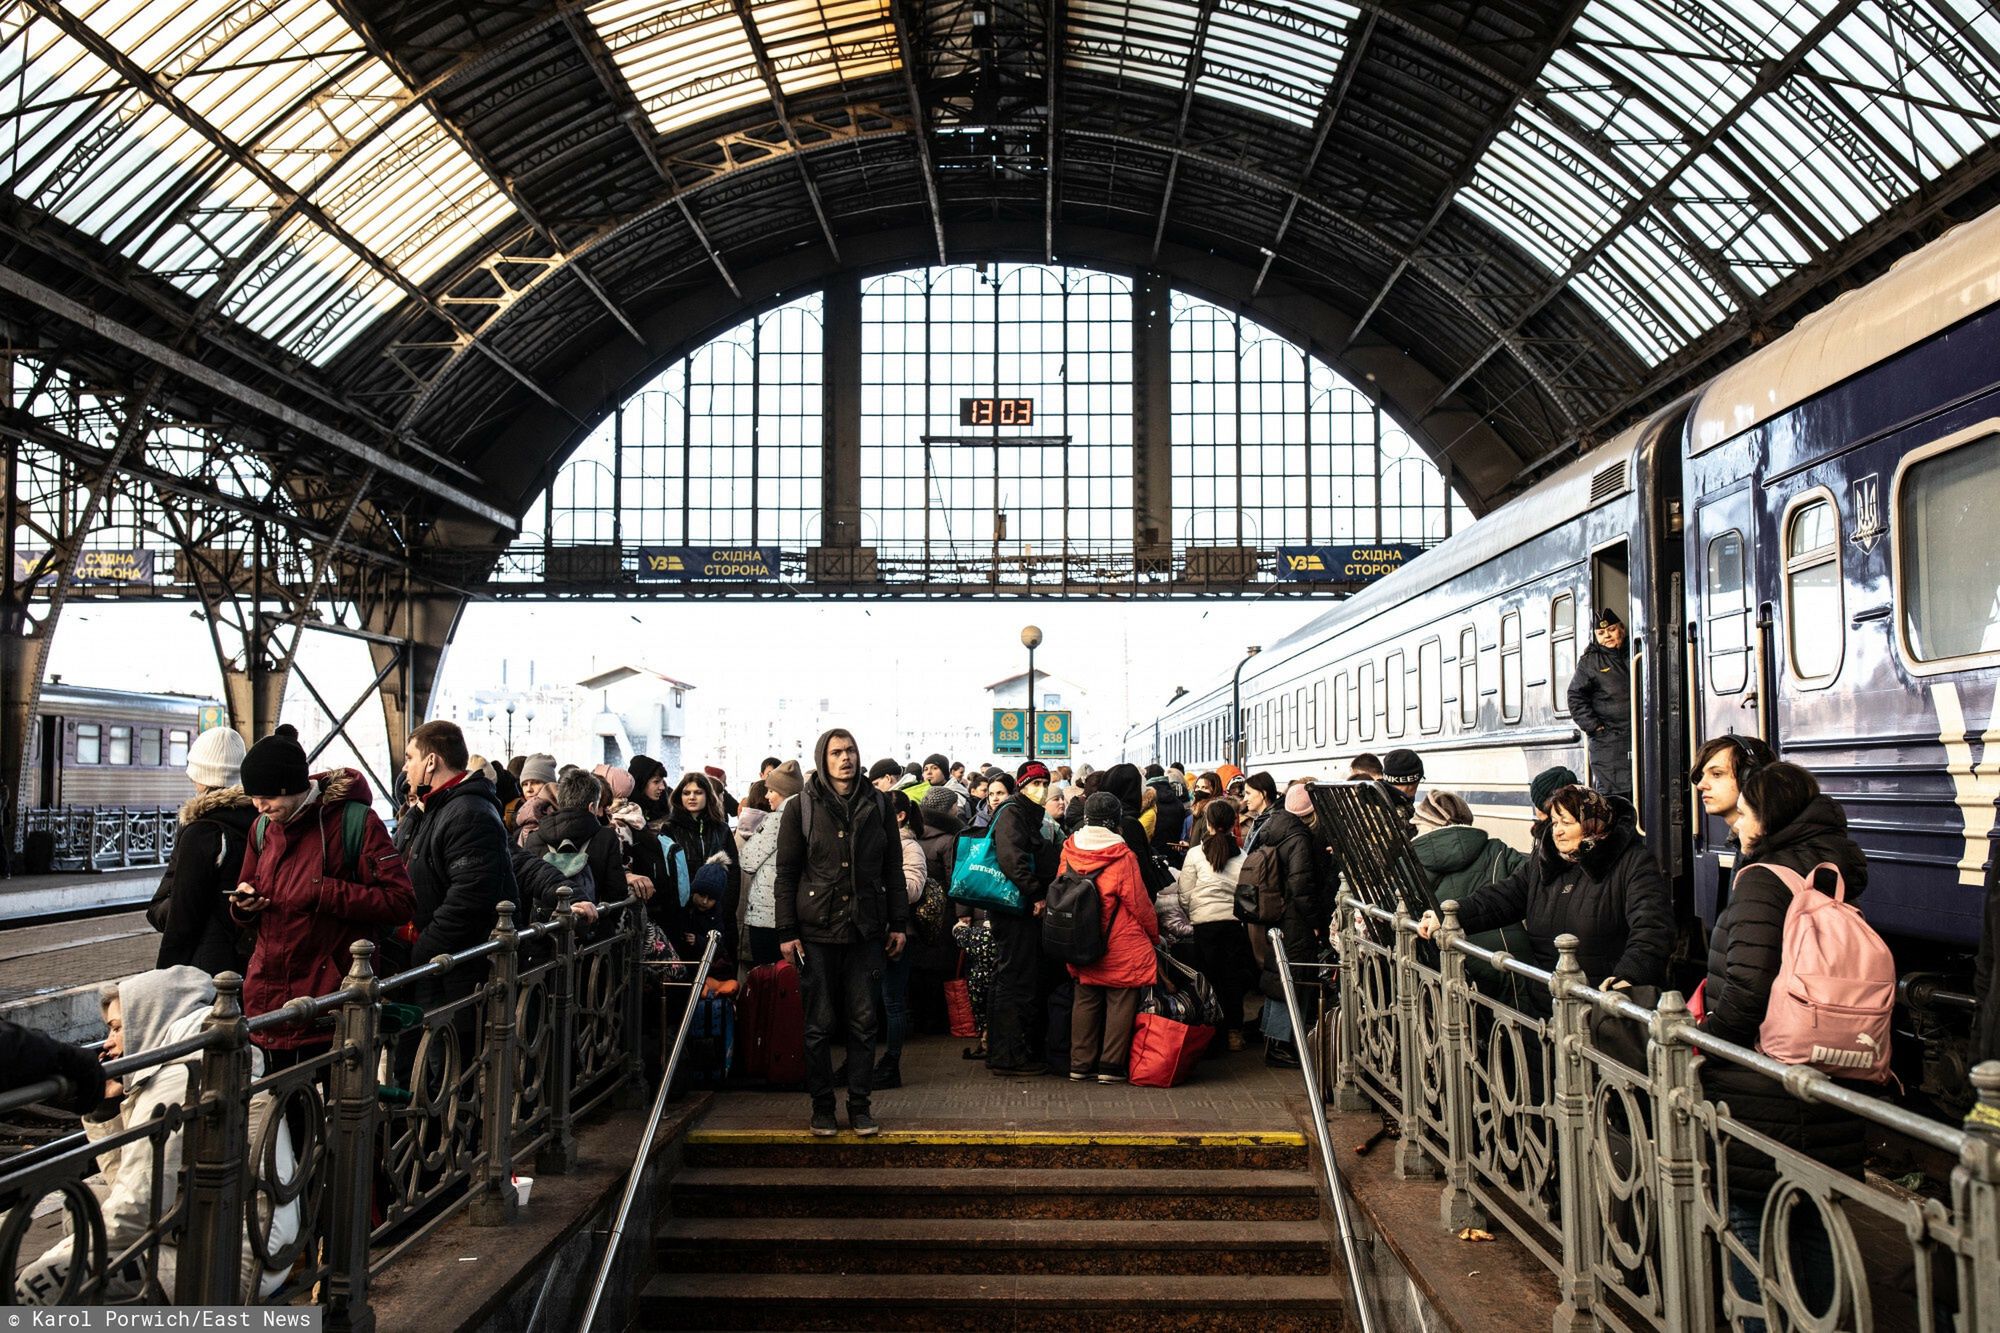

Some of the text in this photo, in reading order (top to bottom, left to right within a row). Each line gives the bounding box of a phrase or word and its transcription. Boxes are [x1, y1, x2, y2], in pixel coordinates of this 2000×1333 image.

[85, 553, 134, 565] СХІДНА
[712, 551, 762, 562] СХІДНА
[1352, 549, 1402, 561] СХІДНА
[77, 567, 141, 579] СТОРОНА
[704, 564, 769, 576] СТОРОНА
[999, 730, 1019, 741] 838
[1043, 733, 1063, 743] 838
[1810, 1045, 1873, 1069] PUMA
